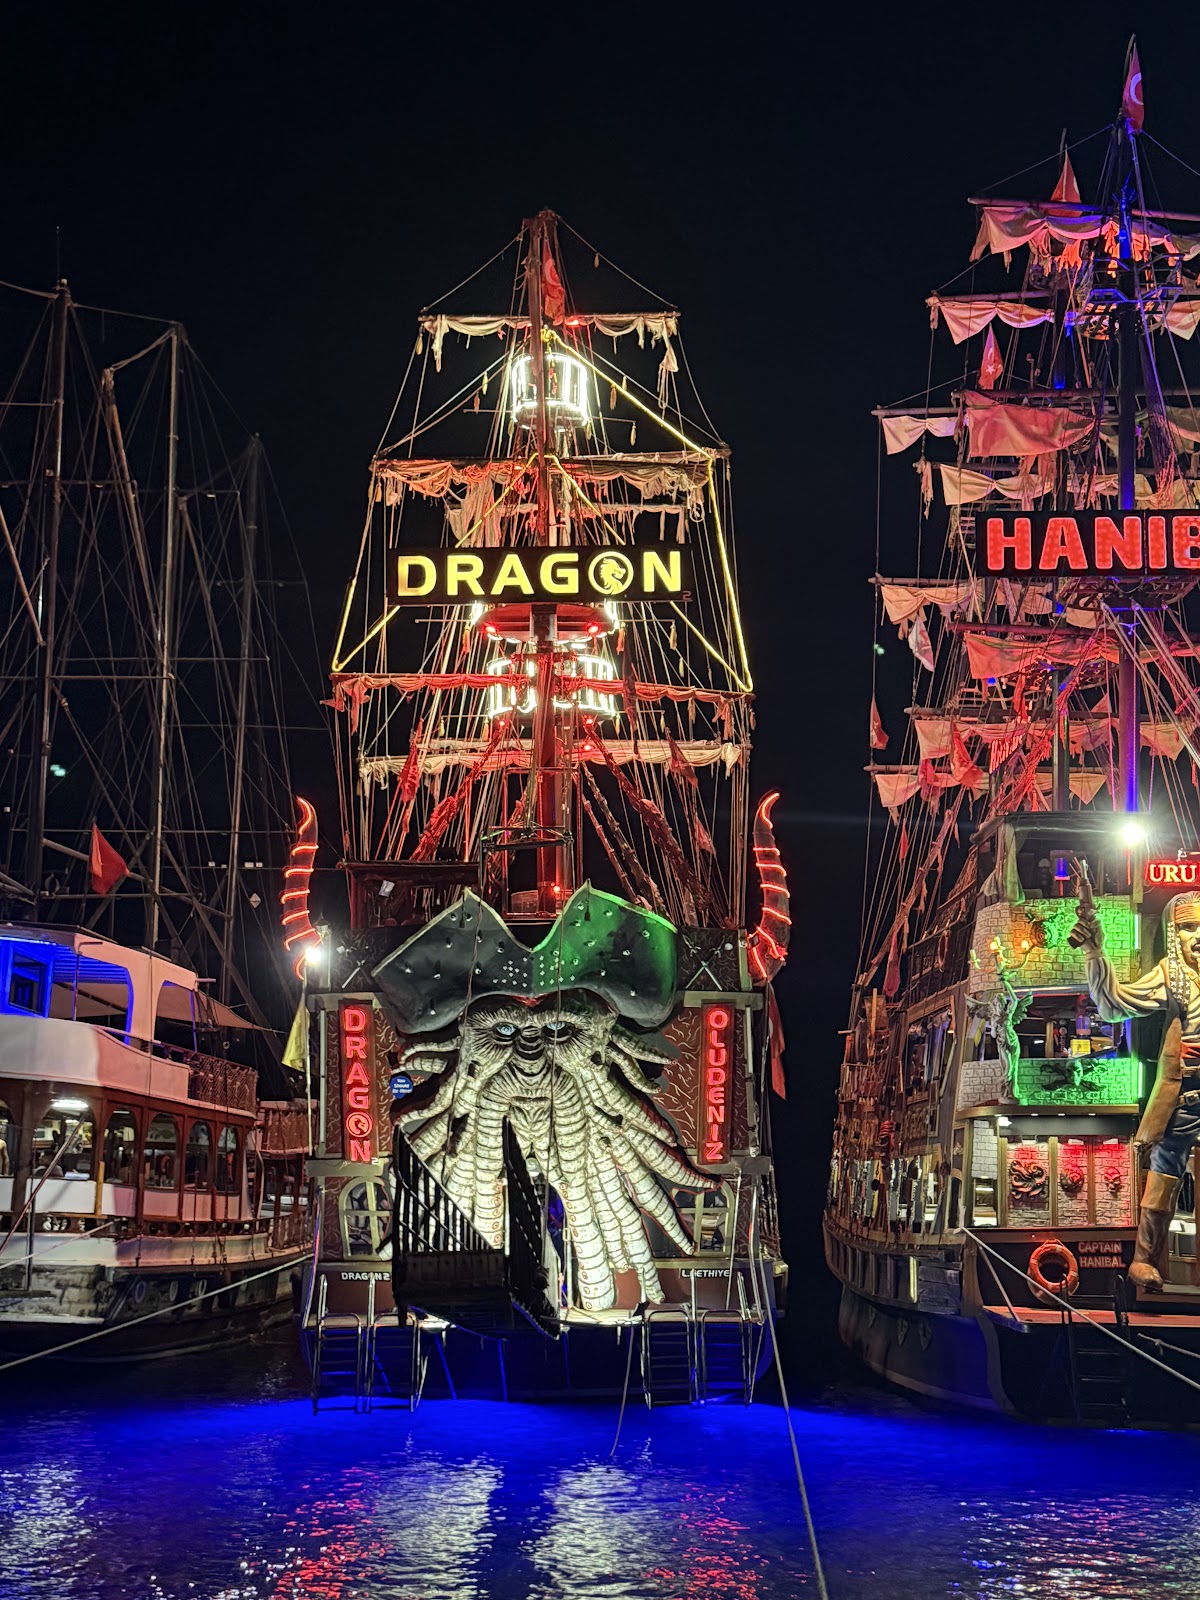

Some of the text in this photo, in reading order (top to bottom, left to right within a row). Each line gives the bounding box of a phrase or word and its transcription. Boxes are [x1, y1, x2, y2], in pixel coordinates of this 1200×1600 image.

[987, 516, 1200, 570] HANIB
[397, 551, 681, 596] DRAGON
[343, 1008, 372, 1162] DRAGON
[1078, 1241, 1123, 1254] CAPTAIN
[1079, 1256, 1127, 1268] HANIBAL
